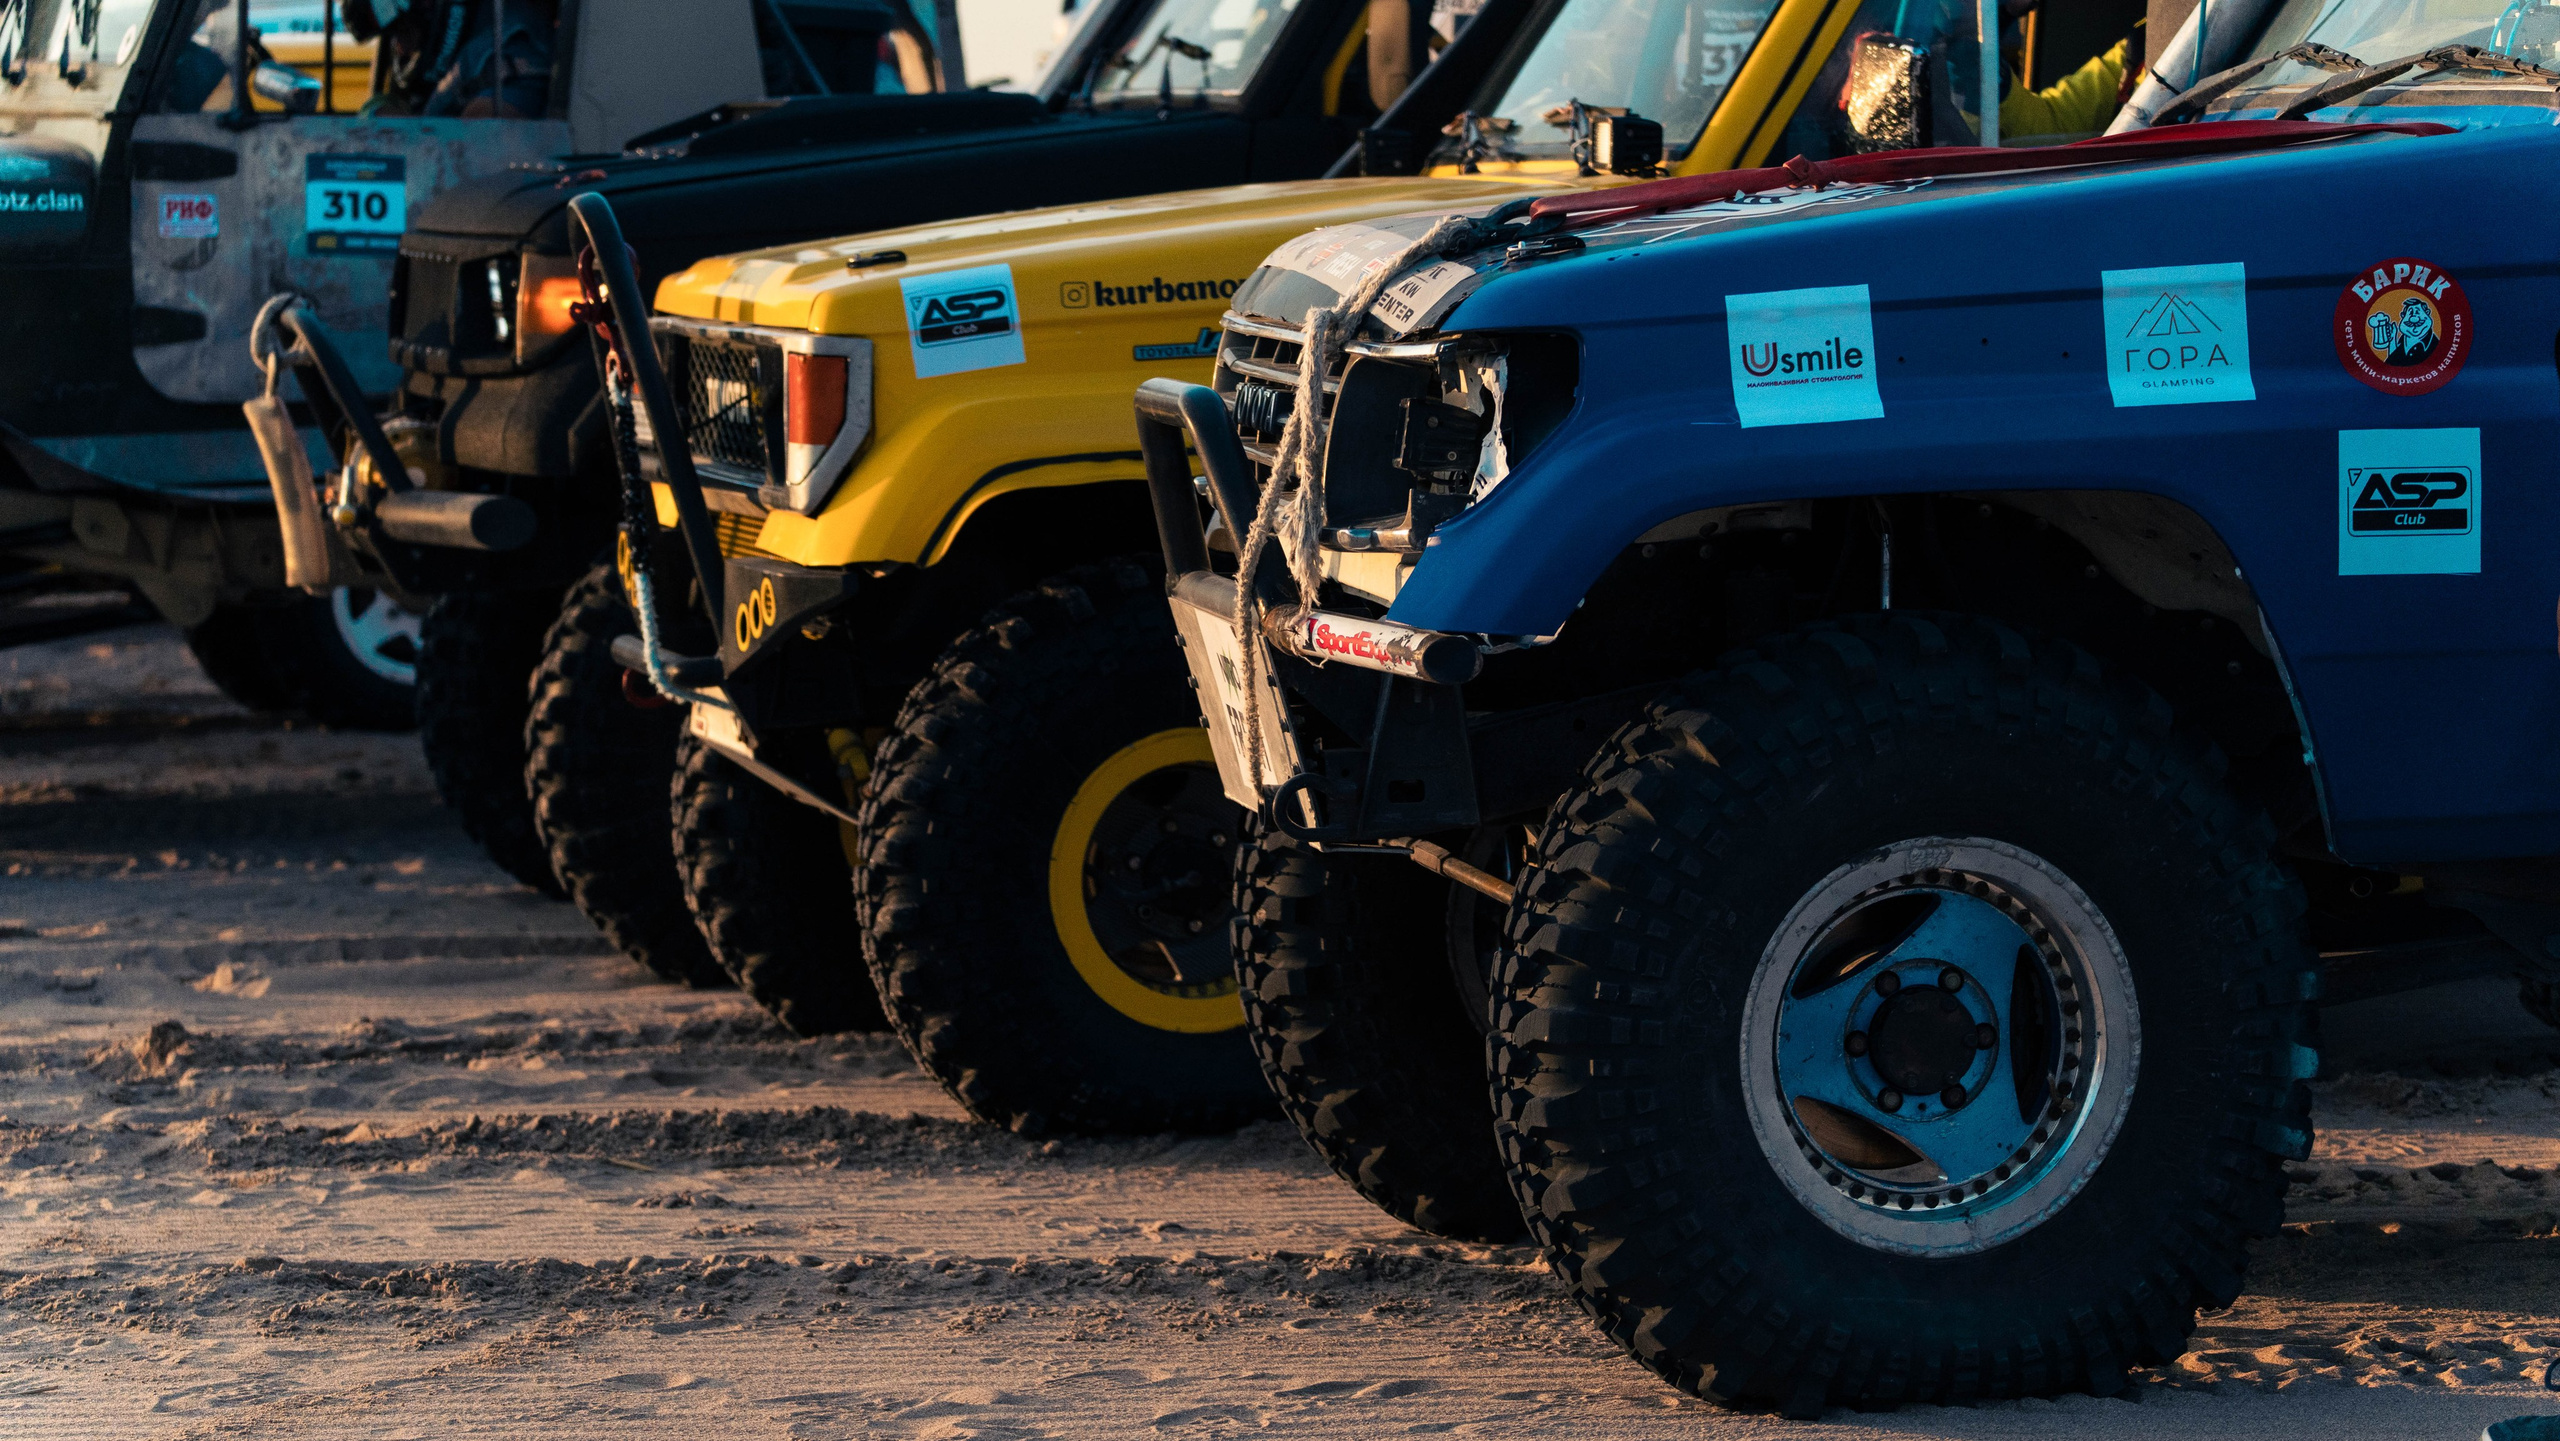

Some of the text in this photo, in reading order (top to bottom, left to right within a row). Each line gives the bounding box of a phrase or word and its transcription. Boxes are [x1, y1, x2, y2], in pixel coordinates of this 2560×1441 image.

[323, 190, 388, 221] 310
[1094, 277, 1247, 306] kurbano
[2351, 263, 2451, 303] БАРИК
[921, 290, 1005, 326] ASP
[1377, 292, 1415, 324] ENTER
[952, 324, 978, 335] Club
[1139, 347, 1189, 358] TOYOTA
[1741, 337, 1863, 377] Usmile
[2345, 313, 2462, 386] сеть мини-маркетов напитков
[1811, 374, 1863, 384] СТОМАТОЛОГИЯ
[2142, 377, 2215, 388] GLAMPING
[2353, 472, 2467, 509] ASP
[2394, 513, 2426, 525] Club
